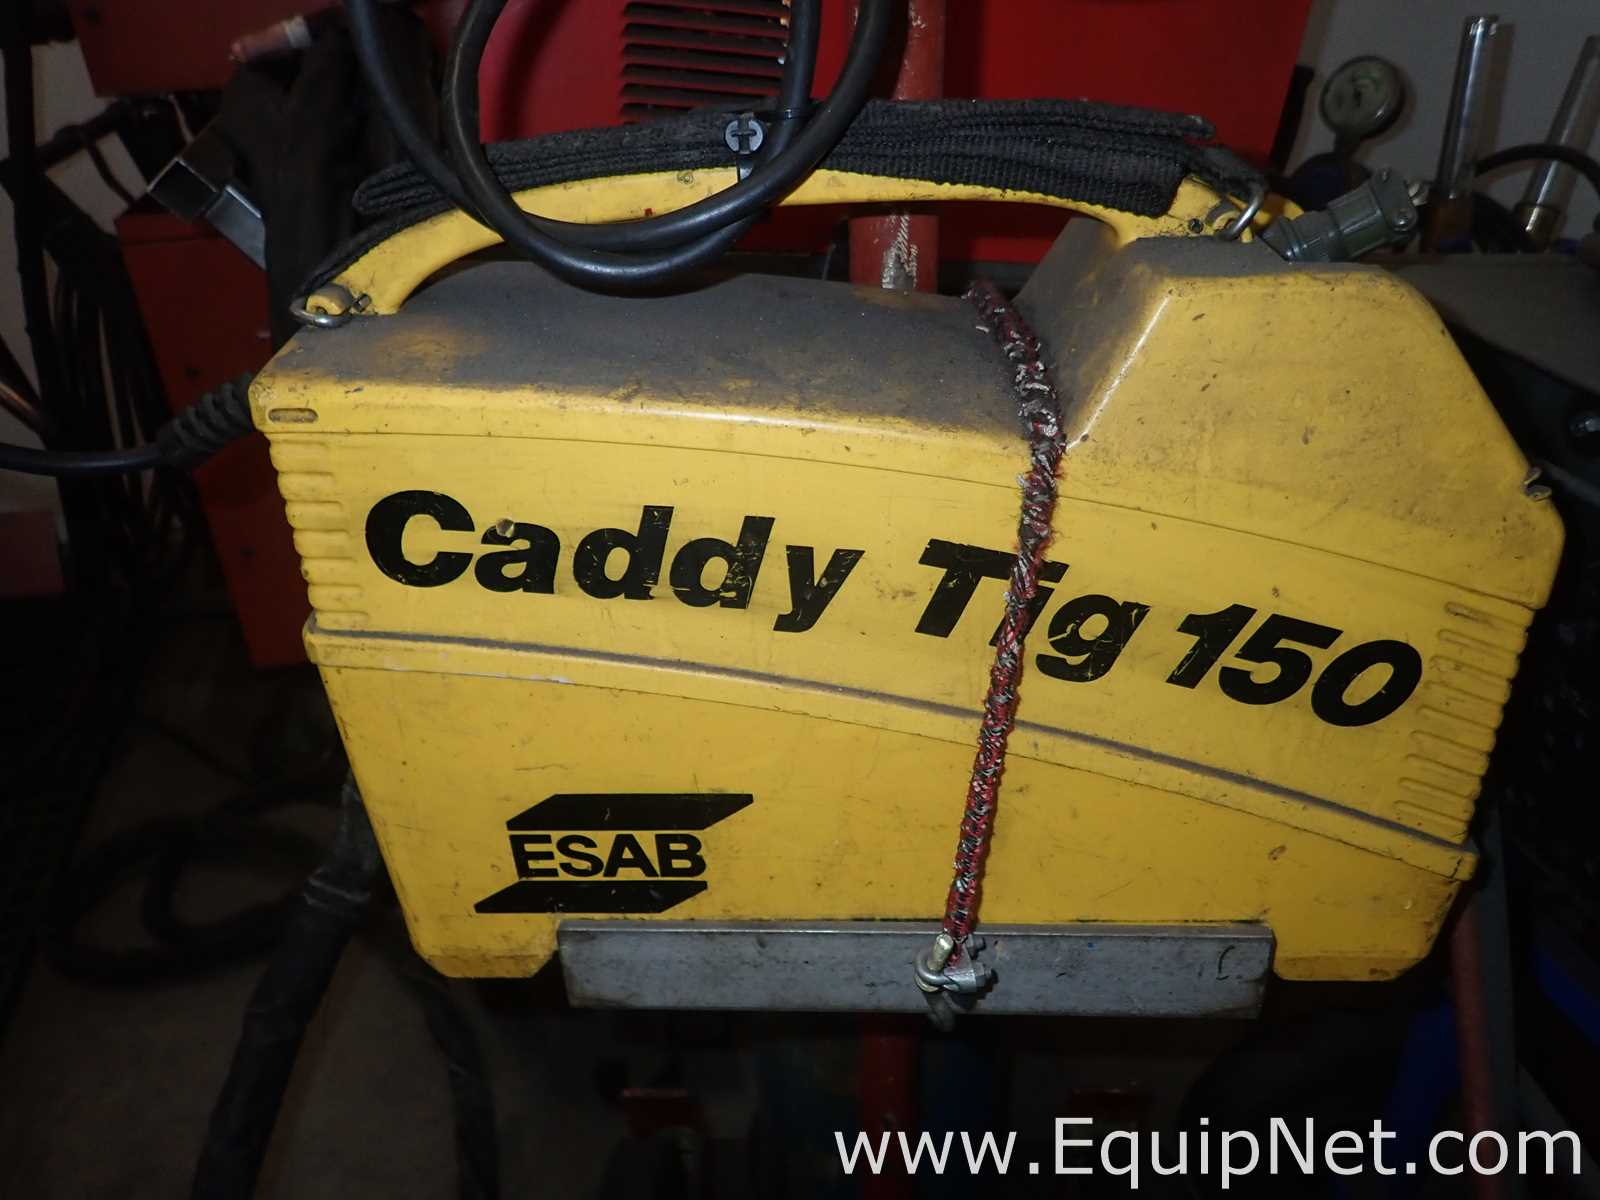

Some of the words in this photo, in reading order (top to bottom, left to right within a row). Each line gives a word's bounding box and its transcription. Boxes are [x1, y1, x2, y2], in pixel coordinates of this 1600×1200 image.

[365, 489, 865, 633] Caddy
[914, 538, 1150, 683] Tig
[1166, 603, 1423, 727] 150
[509, 833, 707, 879] ESAB
